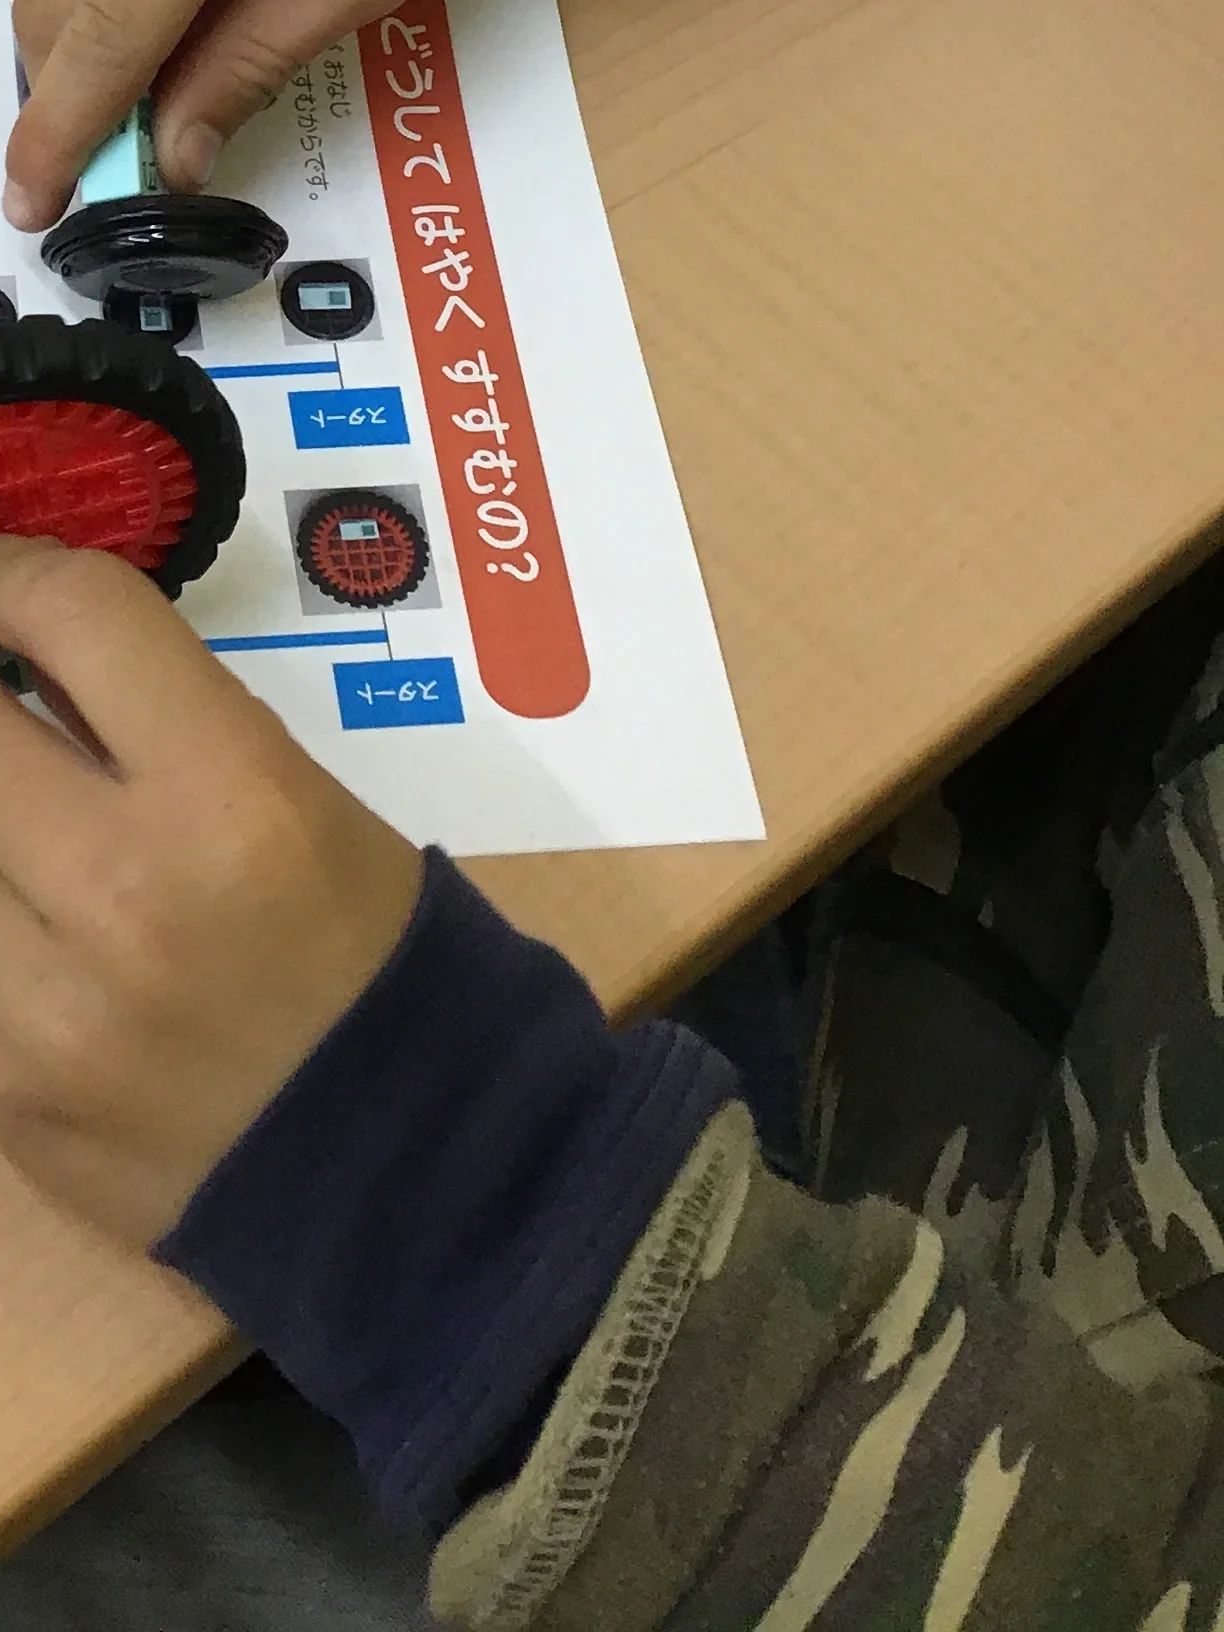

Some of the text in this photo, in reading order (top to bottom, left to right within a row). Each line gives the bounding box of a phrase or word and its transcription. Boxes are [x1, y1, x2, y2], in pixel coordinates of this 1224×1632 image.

[323, 59, 354, 119] おなじ
[290, 64, 329, 202] すむからです。
[379, 17, 541, 583] どうして はやく すすむの?
[309, 406, 387, 428] スタート
[355, 680, 440, 706] スタート
